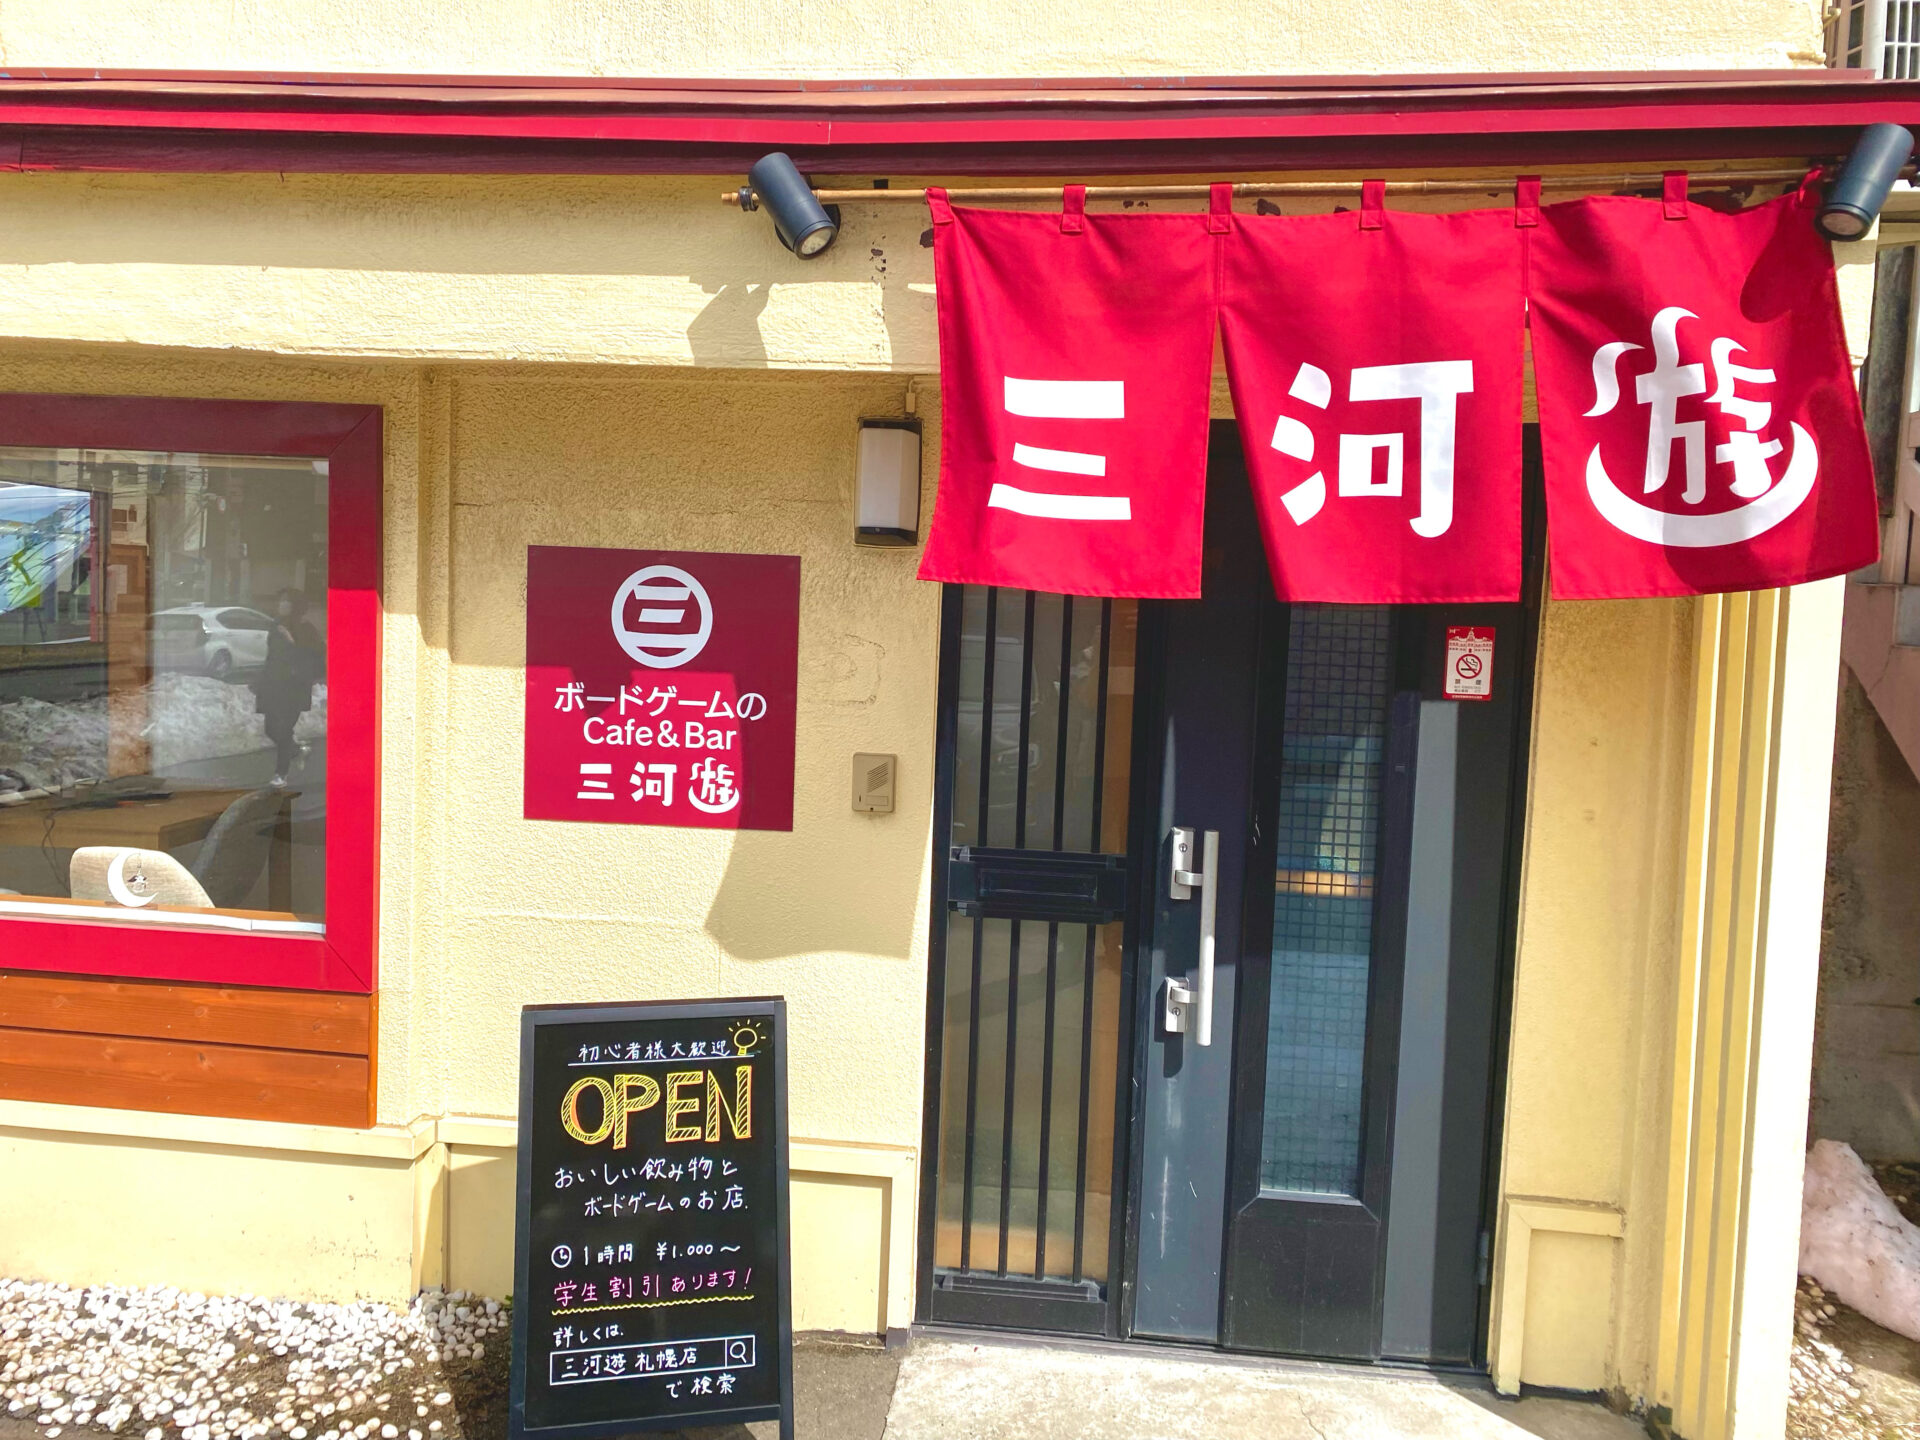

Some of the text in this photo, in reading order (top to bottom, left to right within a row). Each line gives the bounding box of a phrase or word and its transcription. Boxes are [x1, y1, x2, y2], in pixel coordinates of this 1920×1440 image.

[553, 681, 767, 721] ボードゲームの
[578, 1040, 731, 1063] 初心者様大歓迎
[560, 1065, 752, 1150] OPEN
[554, 1156, 738, 1189] おいしい飲み物と
[666, 1373, 738, 1399] で検索
